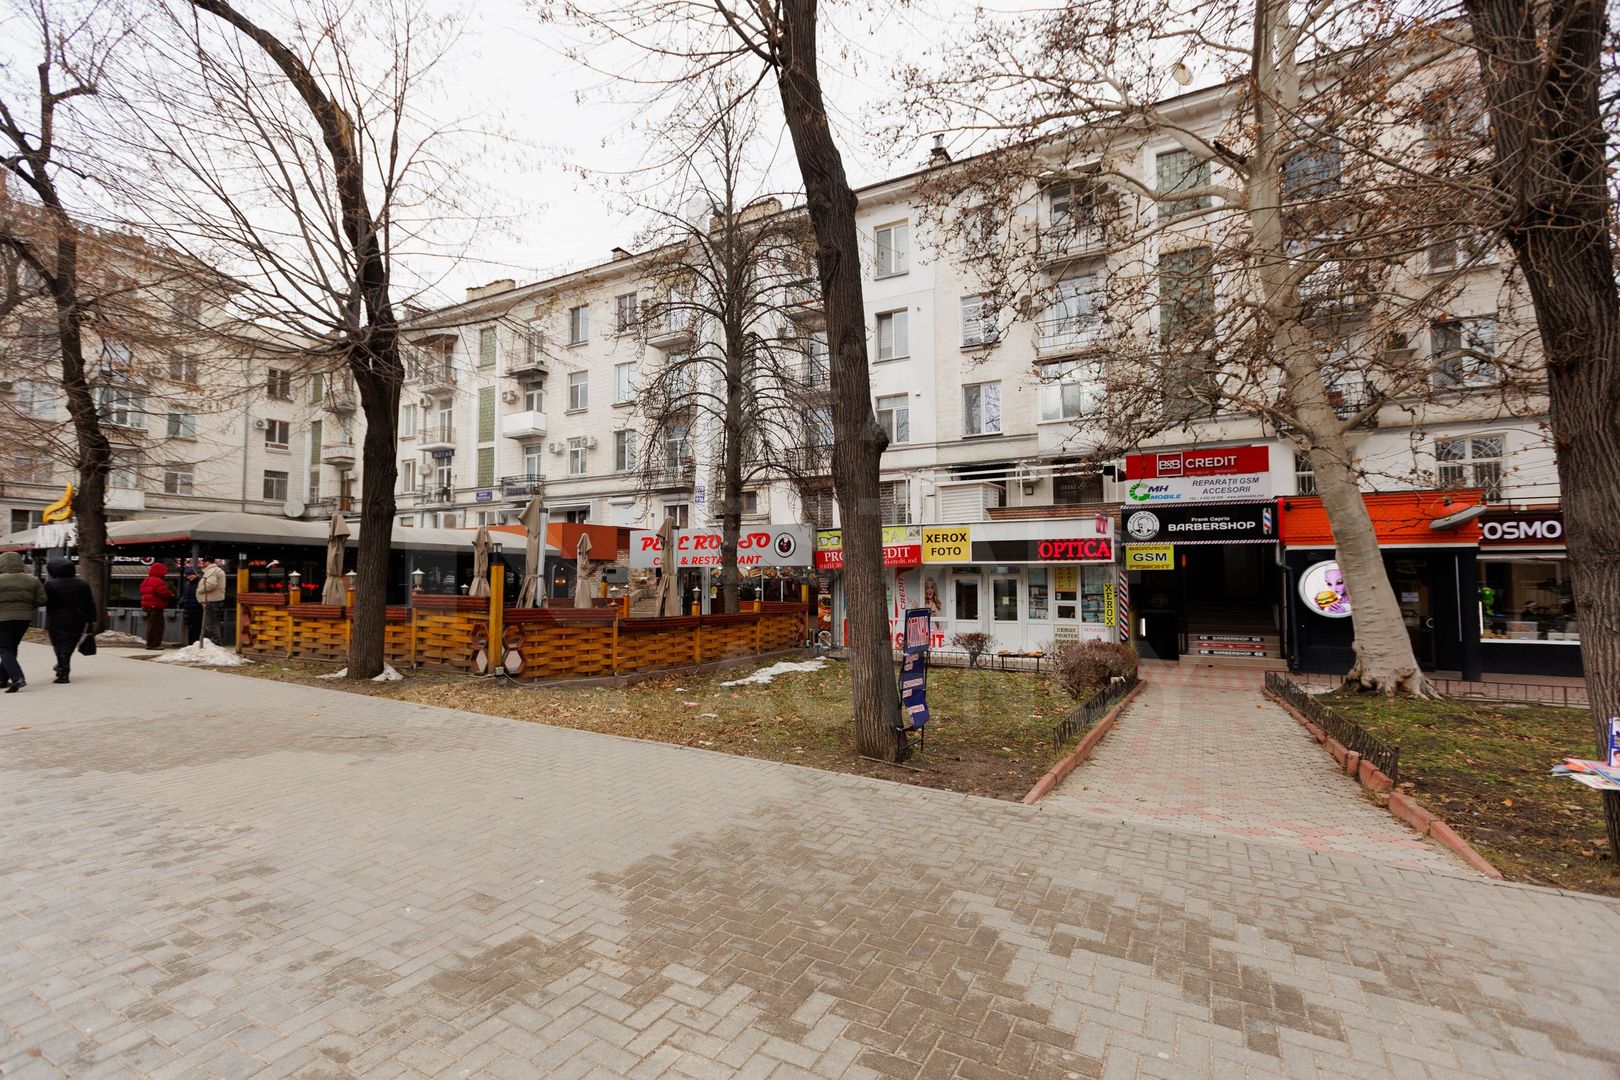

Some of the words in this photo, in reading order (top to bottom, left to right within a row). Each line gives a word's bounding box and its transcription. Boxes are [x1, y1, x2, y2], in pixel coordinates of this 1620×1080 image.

[1159, 459, 1181, 470] B&B
[1185, 455, 1237, 468] CREDIT
[1239, 476, 1260, 485] GSM
[1147, 485, 1169, 493] MH
[1202, 486, 1251, 495] ACCESORII
[1168, 521, 1256, 532] BARBERSHOP
[693, 532, 772, 551] ROSO
[926, 533, 967, 543] XEROX
[931, 547, 961, 556] FOTO
[1038, 541, 1111, 558] OPTICA
[680, 554, 689, 565] &
[691, 555, 762, 566] RESTAANT
[1133, 552, 1167, 562] GSM
[1104, 584, 1114, 625] XEROX
